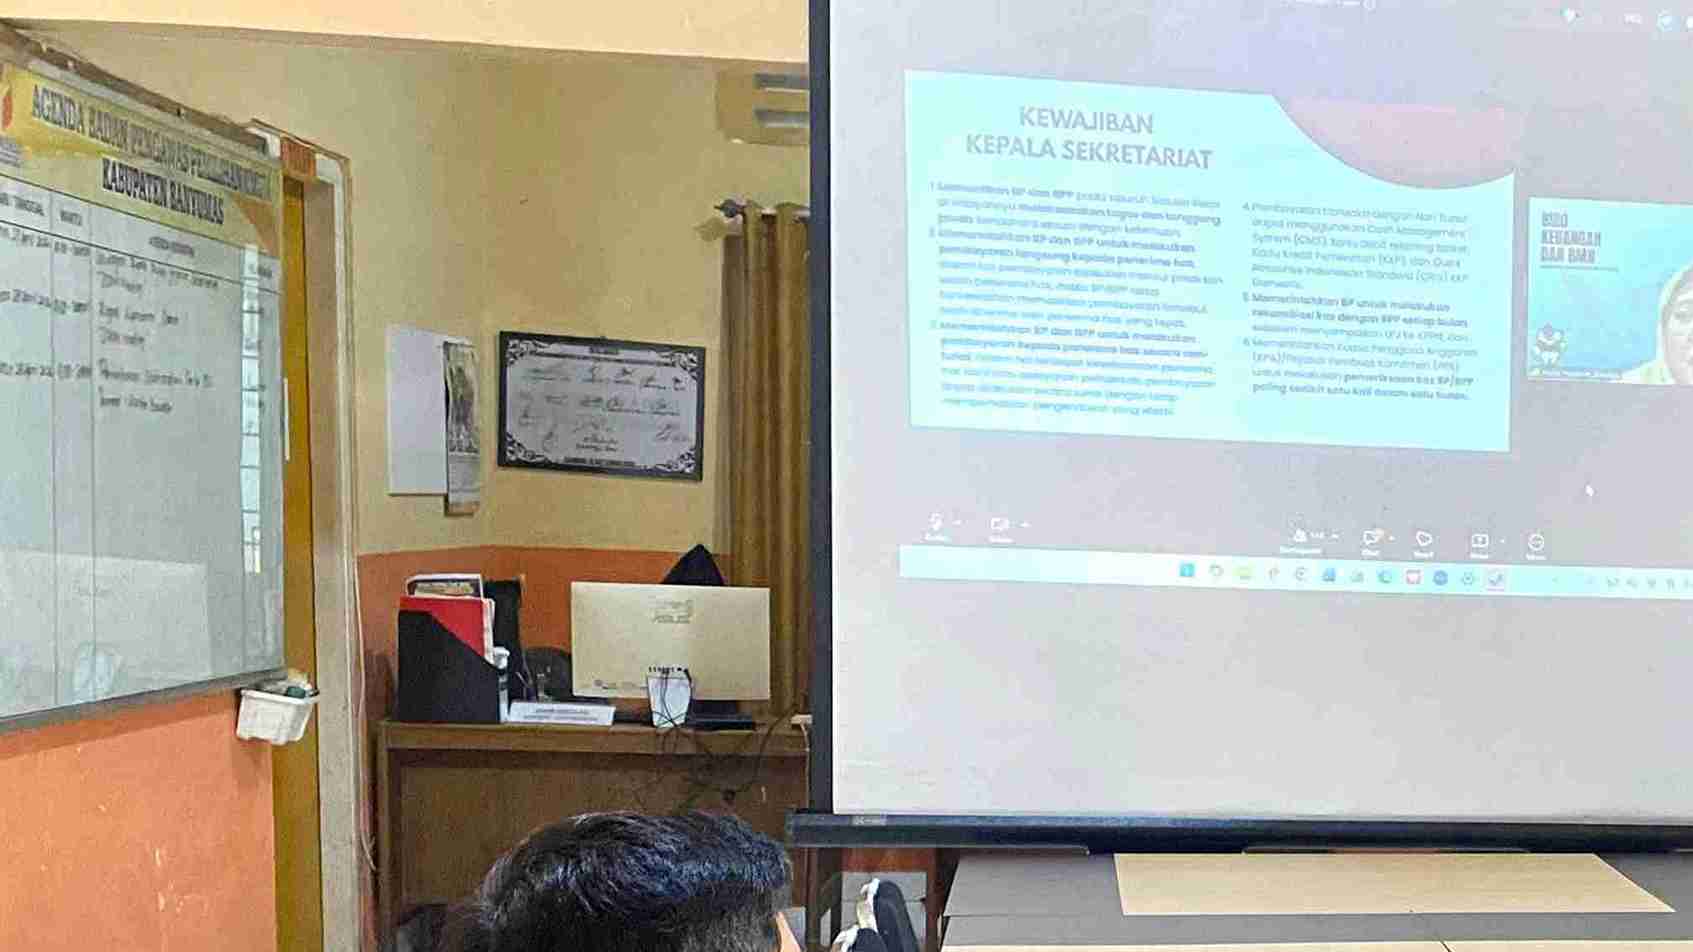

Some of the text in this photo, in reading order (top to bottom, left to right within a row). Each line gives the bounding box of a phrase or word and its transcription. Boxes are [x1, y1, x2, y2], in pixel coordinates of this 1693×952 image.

[32, 83, 84, 134] AGENDA
[1020, 105, 1153, 134] KEWAJIBAN
[966, 133, 1213, 170] KEPALA SEKRETARIAT
[102, 157, 224, 225] KABUPATEN BANYUMAS
